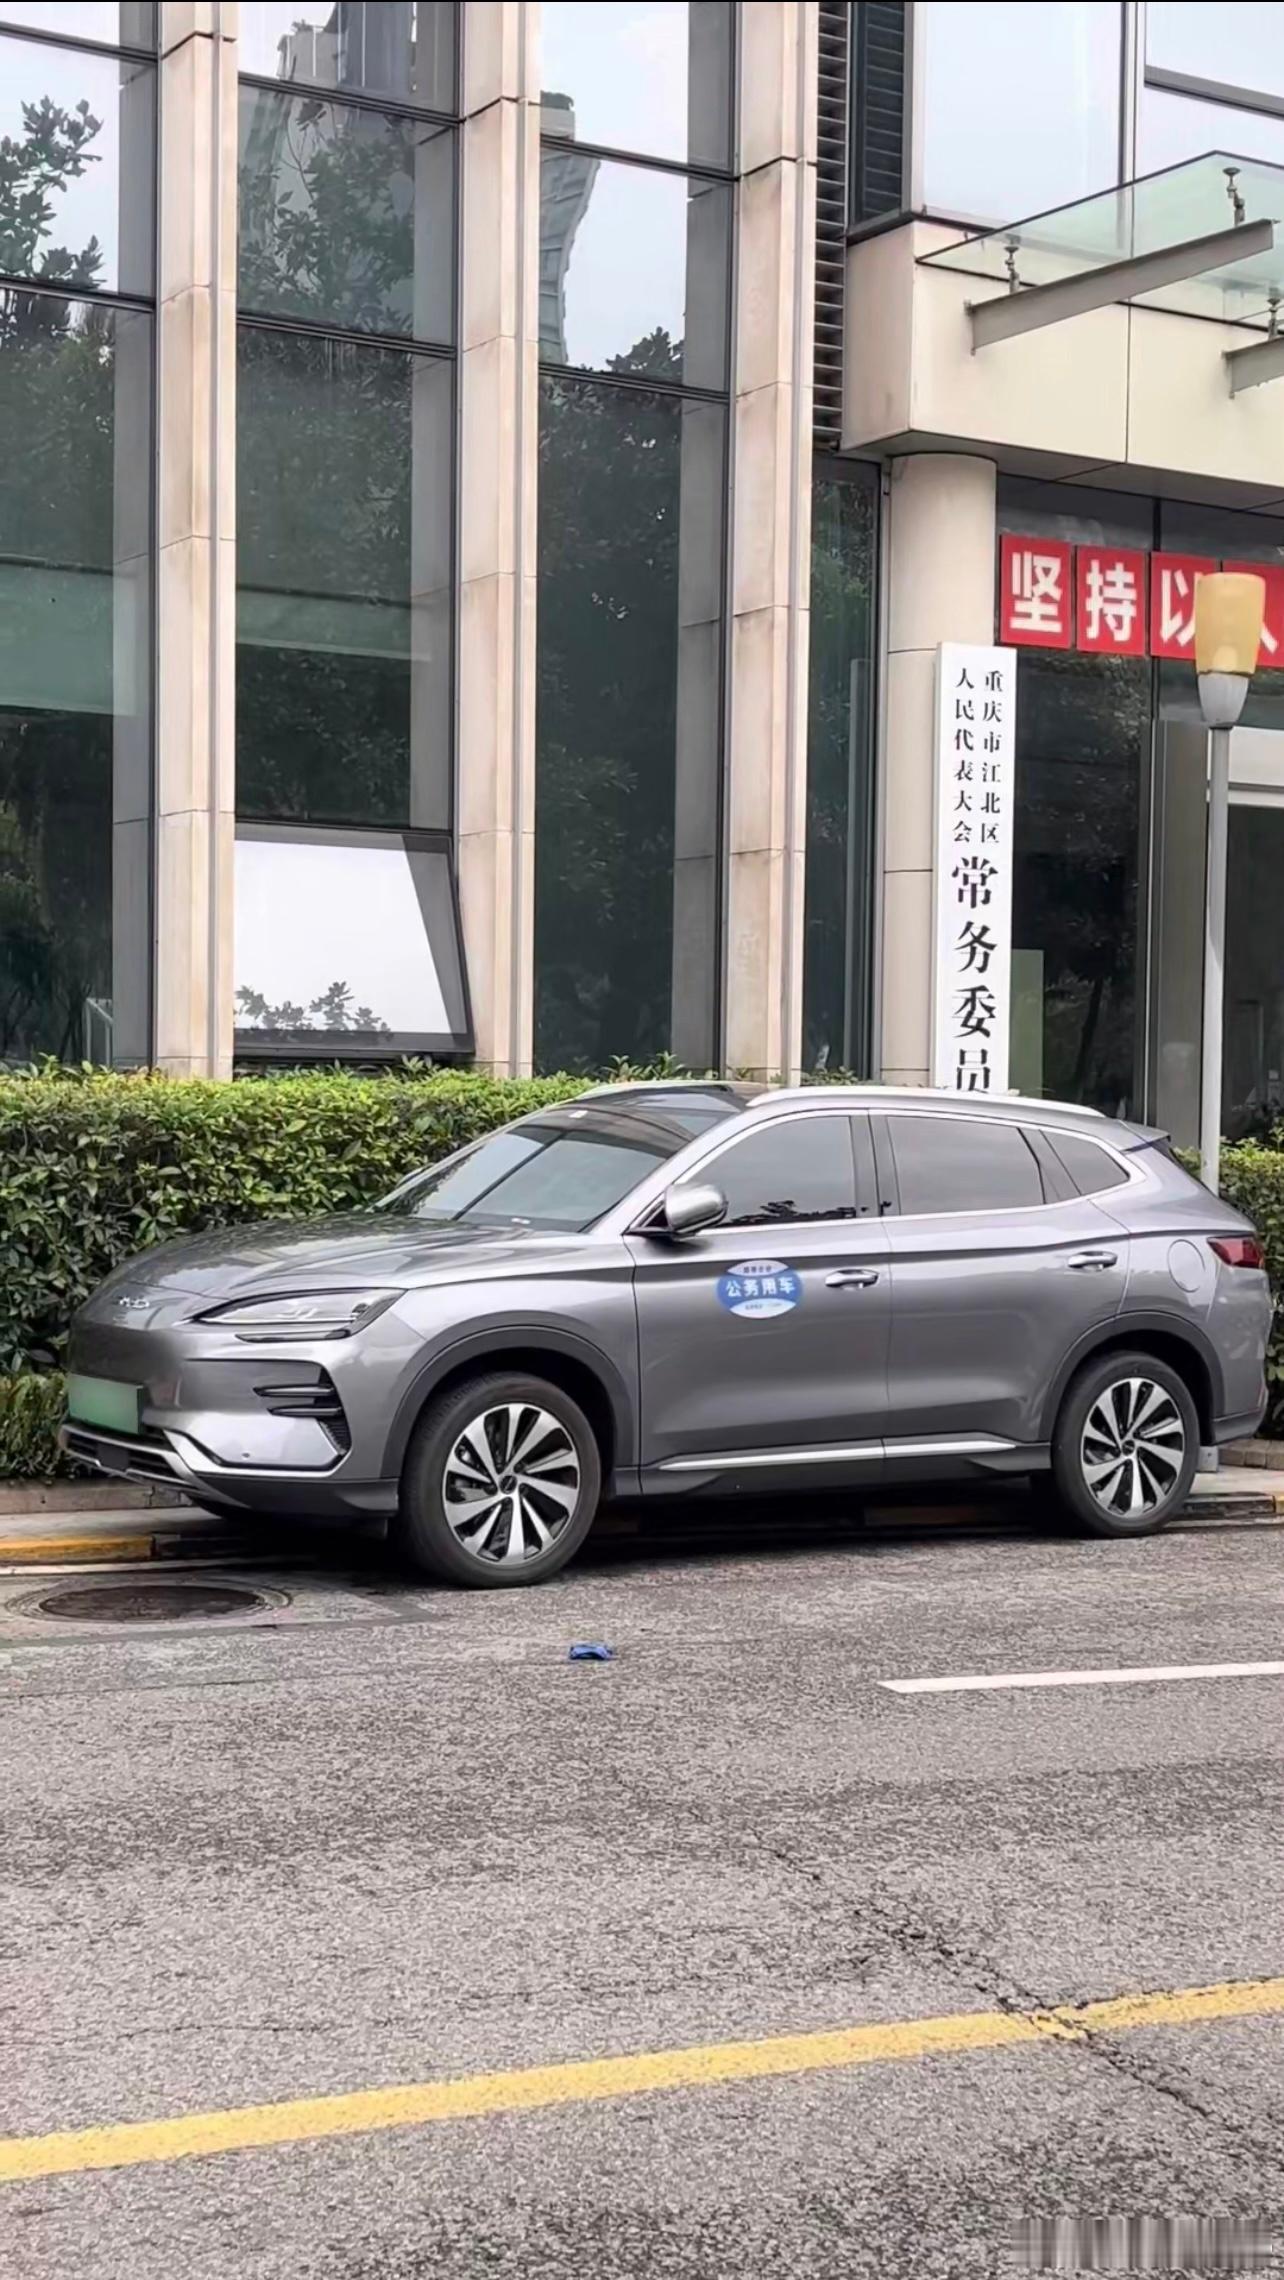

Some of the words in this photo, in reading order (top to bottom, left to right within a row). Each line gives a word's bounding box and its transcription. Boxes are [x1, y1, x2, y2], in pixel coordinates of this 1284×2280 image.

[1009, 551, 1278, 654] 坚持以
[953, 667, 975, 843] 人民代表大会
[980, 669, 1003, 844] 重庆市江北区
[951, 855, 999, 1094] 常务委员
[725, 1277, 796, 1298] 公务用车
